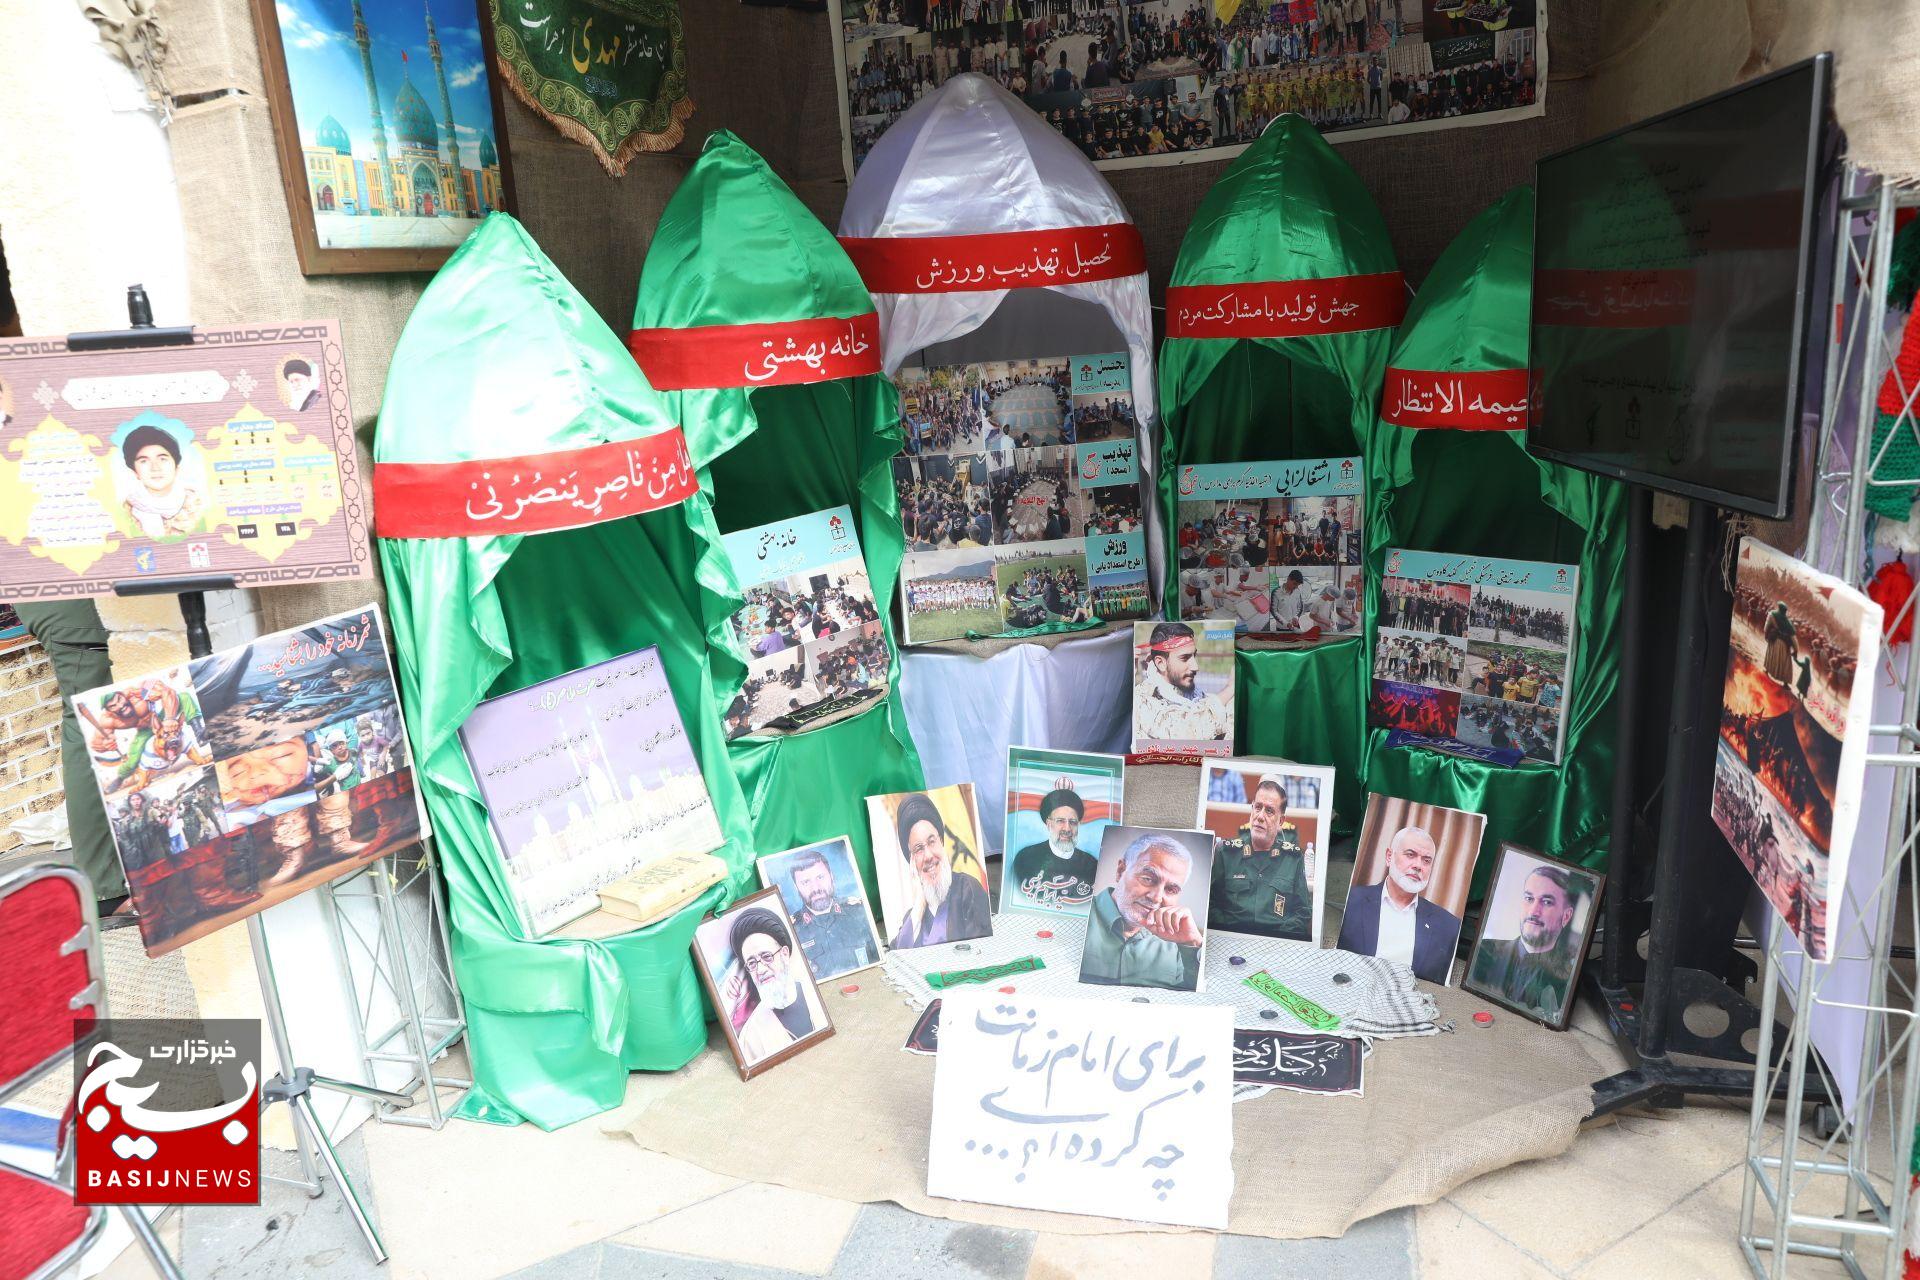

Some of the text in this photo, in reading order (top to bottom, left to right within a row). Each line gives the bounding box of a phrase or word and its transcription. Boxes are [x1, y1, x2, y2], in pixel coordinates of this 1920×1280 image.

[571, 17, 622, 74] مهدی
[638, 33, 653, 58] خانه
[916, 258, 985, 289] ورزش
[1178, 293, 1360, 334] جهش تولید با مشارکت مردم
[744, 322, 869, 381] خانه بهشتی
[1102, 443, 1132, 463] تهذیب
[757, 528, 797, 560] خانه بهشتی
[1103, 539, 1127, 556] ورزش
[305, 643, 317, 660] را
[319, 632, 335, 657] خود
[337, 626, 357, 653] زمانه
[356, 614, 371, 652] شمر
[975, 1004, 1058, 1073] زمانت
[1044, 1033, 1114, 1108] امام
[1112, 1036, 1207, 1093] برای
[1064, 1088, 1188, 1168] کرده
[1142, 1140, 1185, 1202] چه
